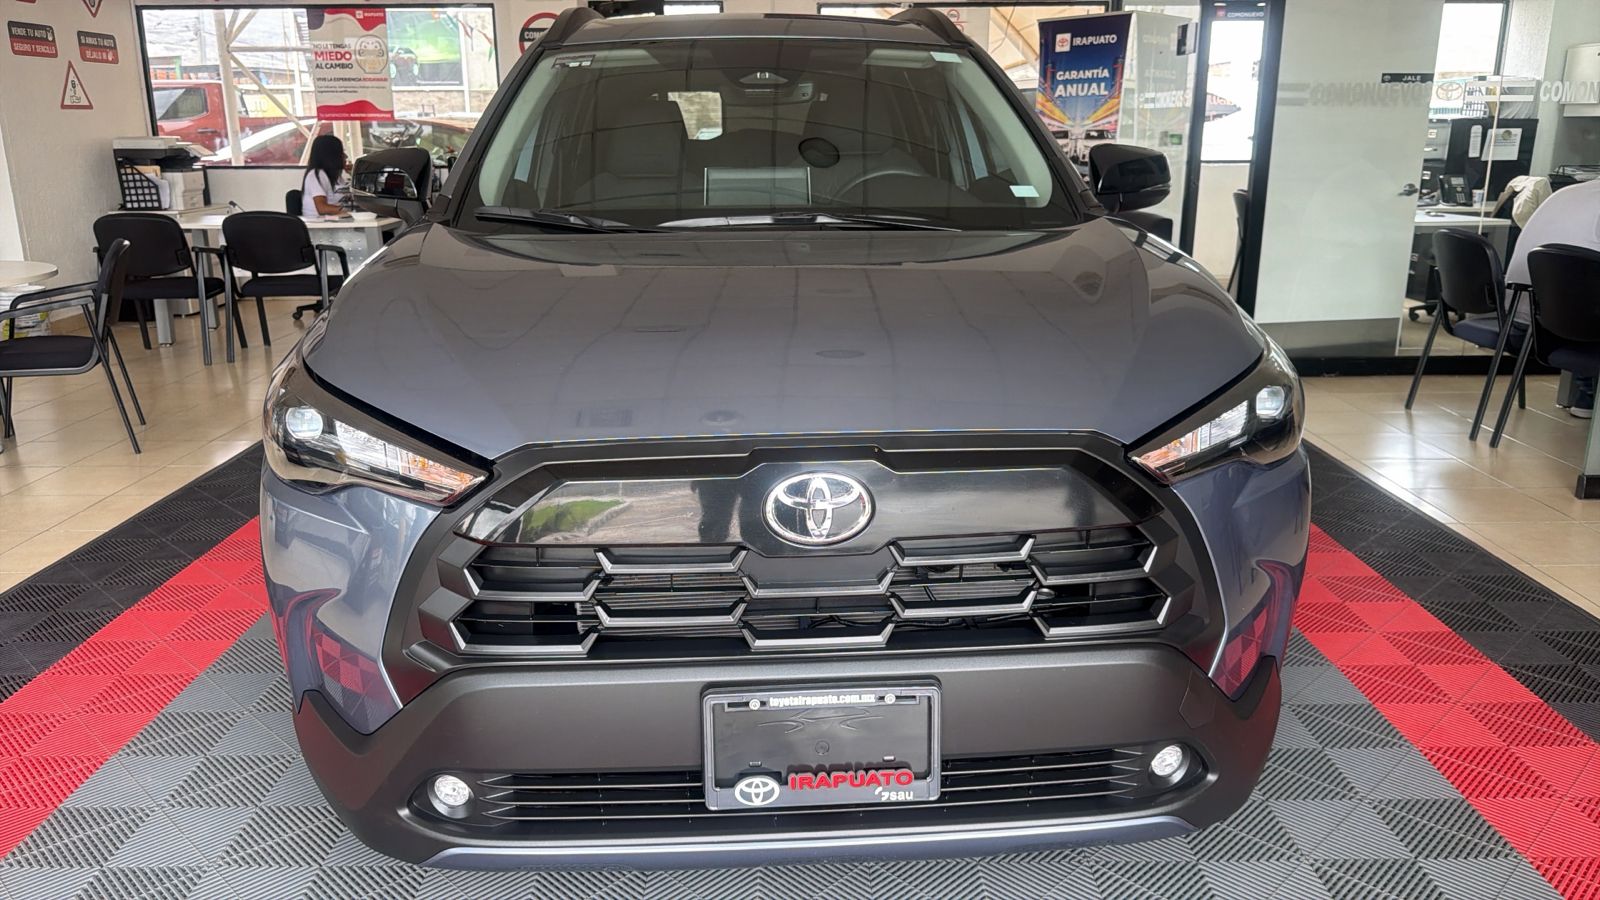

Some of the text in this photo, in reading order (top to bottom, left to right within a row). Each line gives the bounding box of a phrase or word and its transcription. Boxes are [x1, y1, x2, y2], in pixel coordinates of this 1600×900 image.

[27, 28, 34, 37] TU
[34, 29, 47, 38] AUTO
[1072, 34, 1118, 46] IRAPUATO
[314, 51, 352, 61] MIEDO
[1056, 66, 1110, 81] GARANTÍA
[1054, 83, 1109, 98] ANUAL
[770, 694, 876, 708] toyotairapuato.com.mx
[788, 769, 914, 791] IRAPUATO
